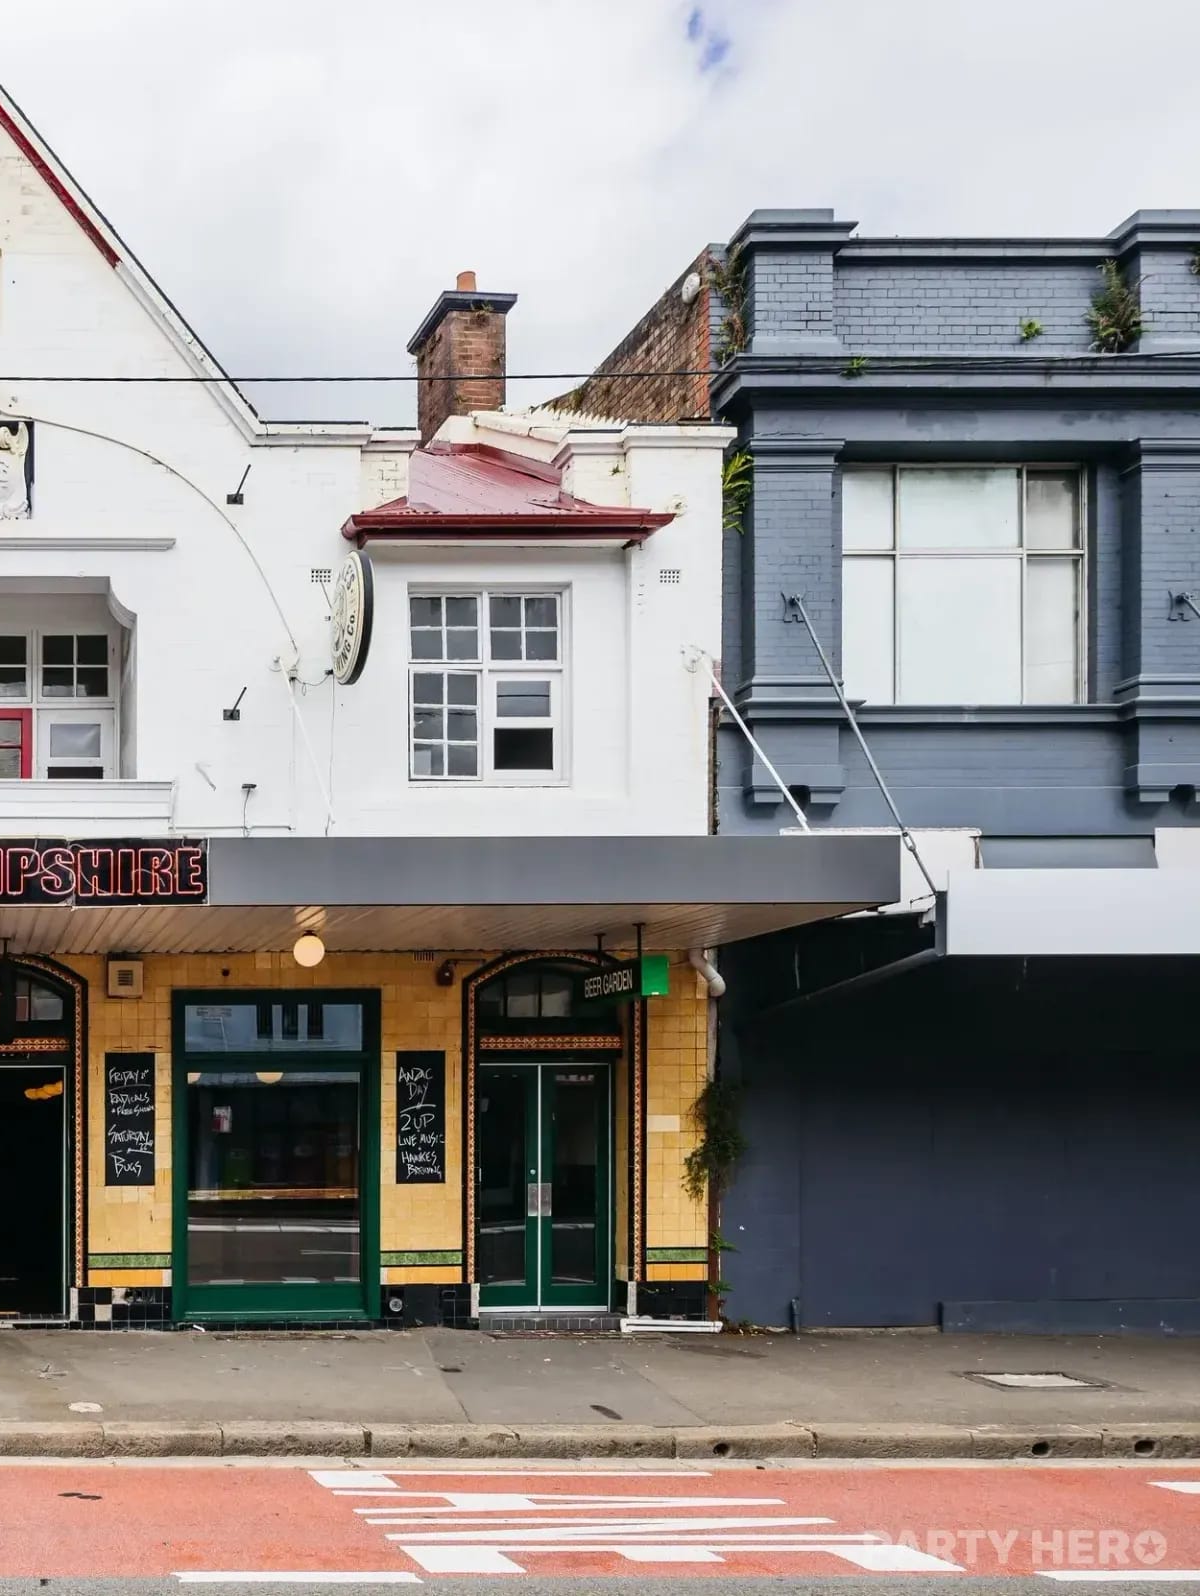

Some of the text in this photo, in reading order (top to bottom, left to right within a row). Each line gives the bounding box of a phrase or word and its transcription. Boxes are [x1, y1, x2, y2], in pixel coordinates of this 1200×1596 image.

[584, 968, 633, 998] BEER GARDEN
[109, 1066, 139, 1085] FRIDAY
[398, 1066, 433, 1082] ANZAC
[405, 1081, 429, 1105] DAY
[398, 1131, 445, 1148] LIVE MUSIC
[111, 1154, 142, 1178] BUGS
